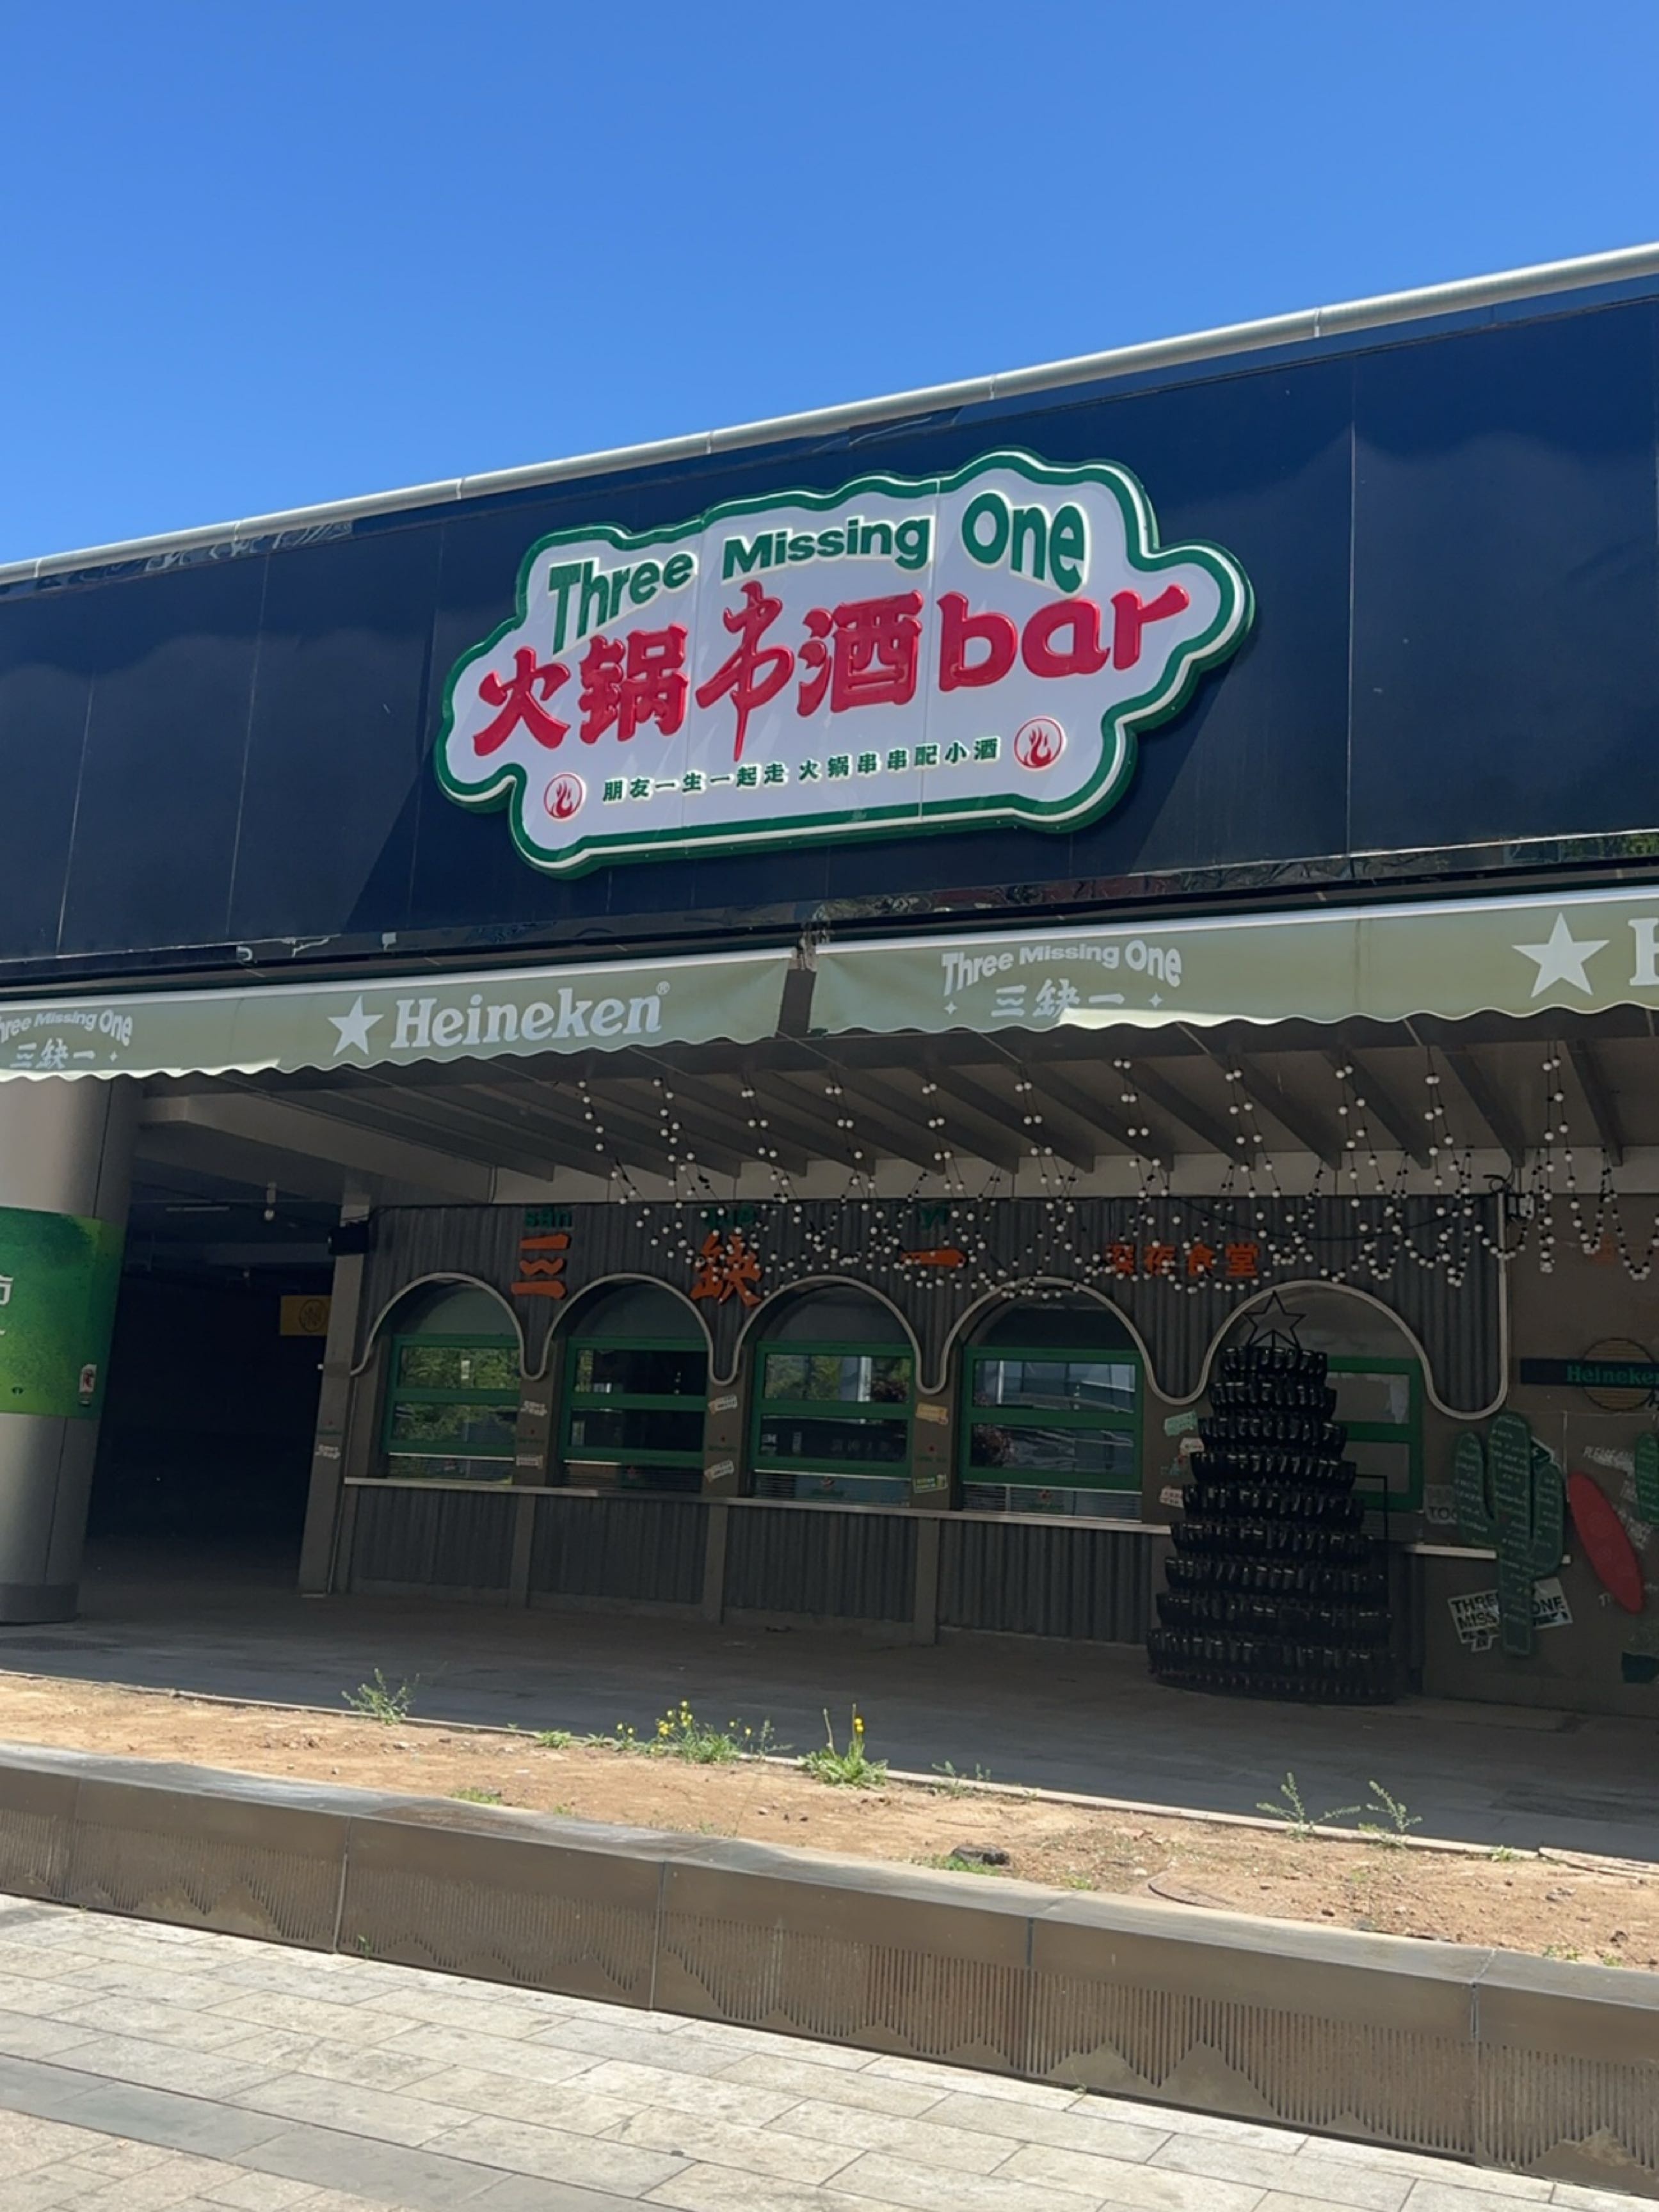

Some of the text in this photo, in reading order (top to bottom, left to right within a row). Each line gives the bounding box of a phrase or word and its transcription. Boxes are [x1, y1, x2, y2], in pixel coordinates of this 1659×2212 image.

[549, 491, 1086, 652] Three Missing One
[603, 737, 997, 801] 朋友一生一起走 火锅串串配小酒
[942, 940, 1182, 997] Three Missing One
[390, 987, 662, 1049] Heineken
[991, 979, 1125, 1018] 三缺一
[33, 1011, 98, 1032] Missing
[100, 1009, 133, 1046] One
[1451, 1593, 1499, 1614] THRE
